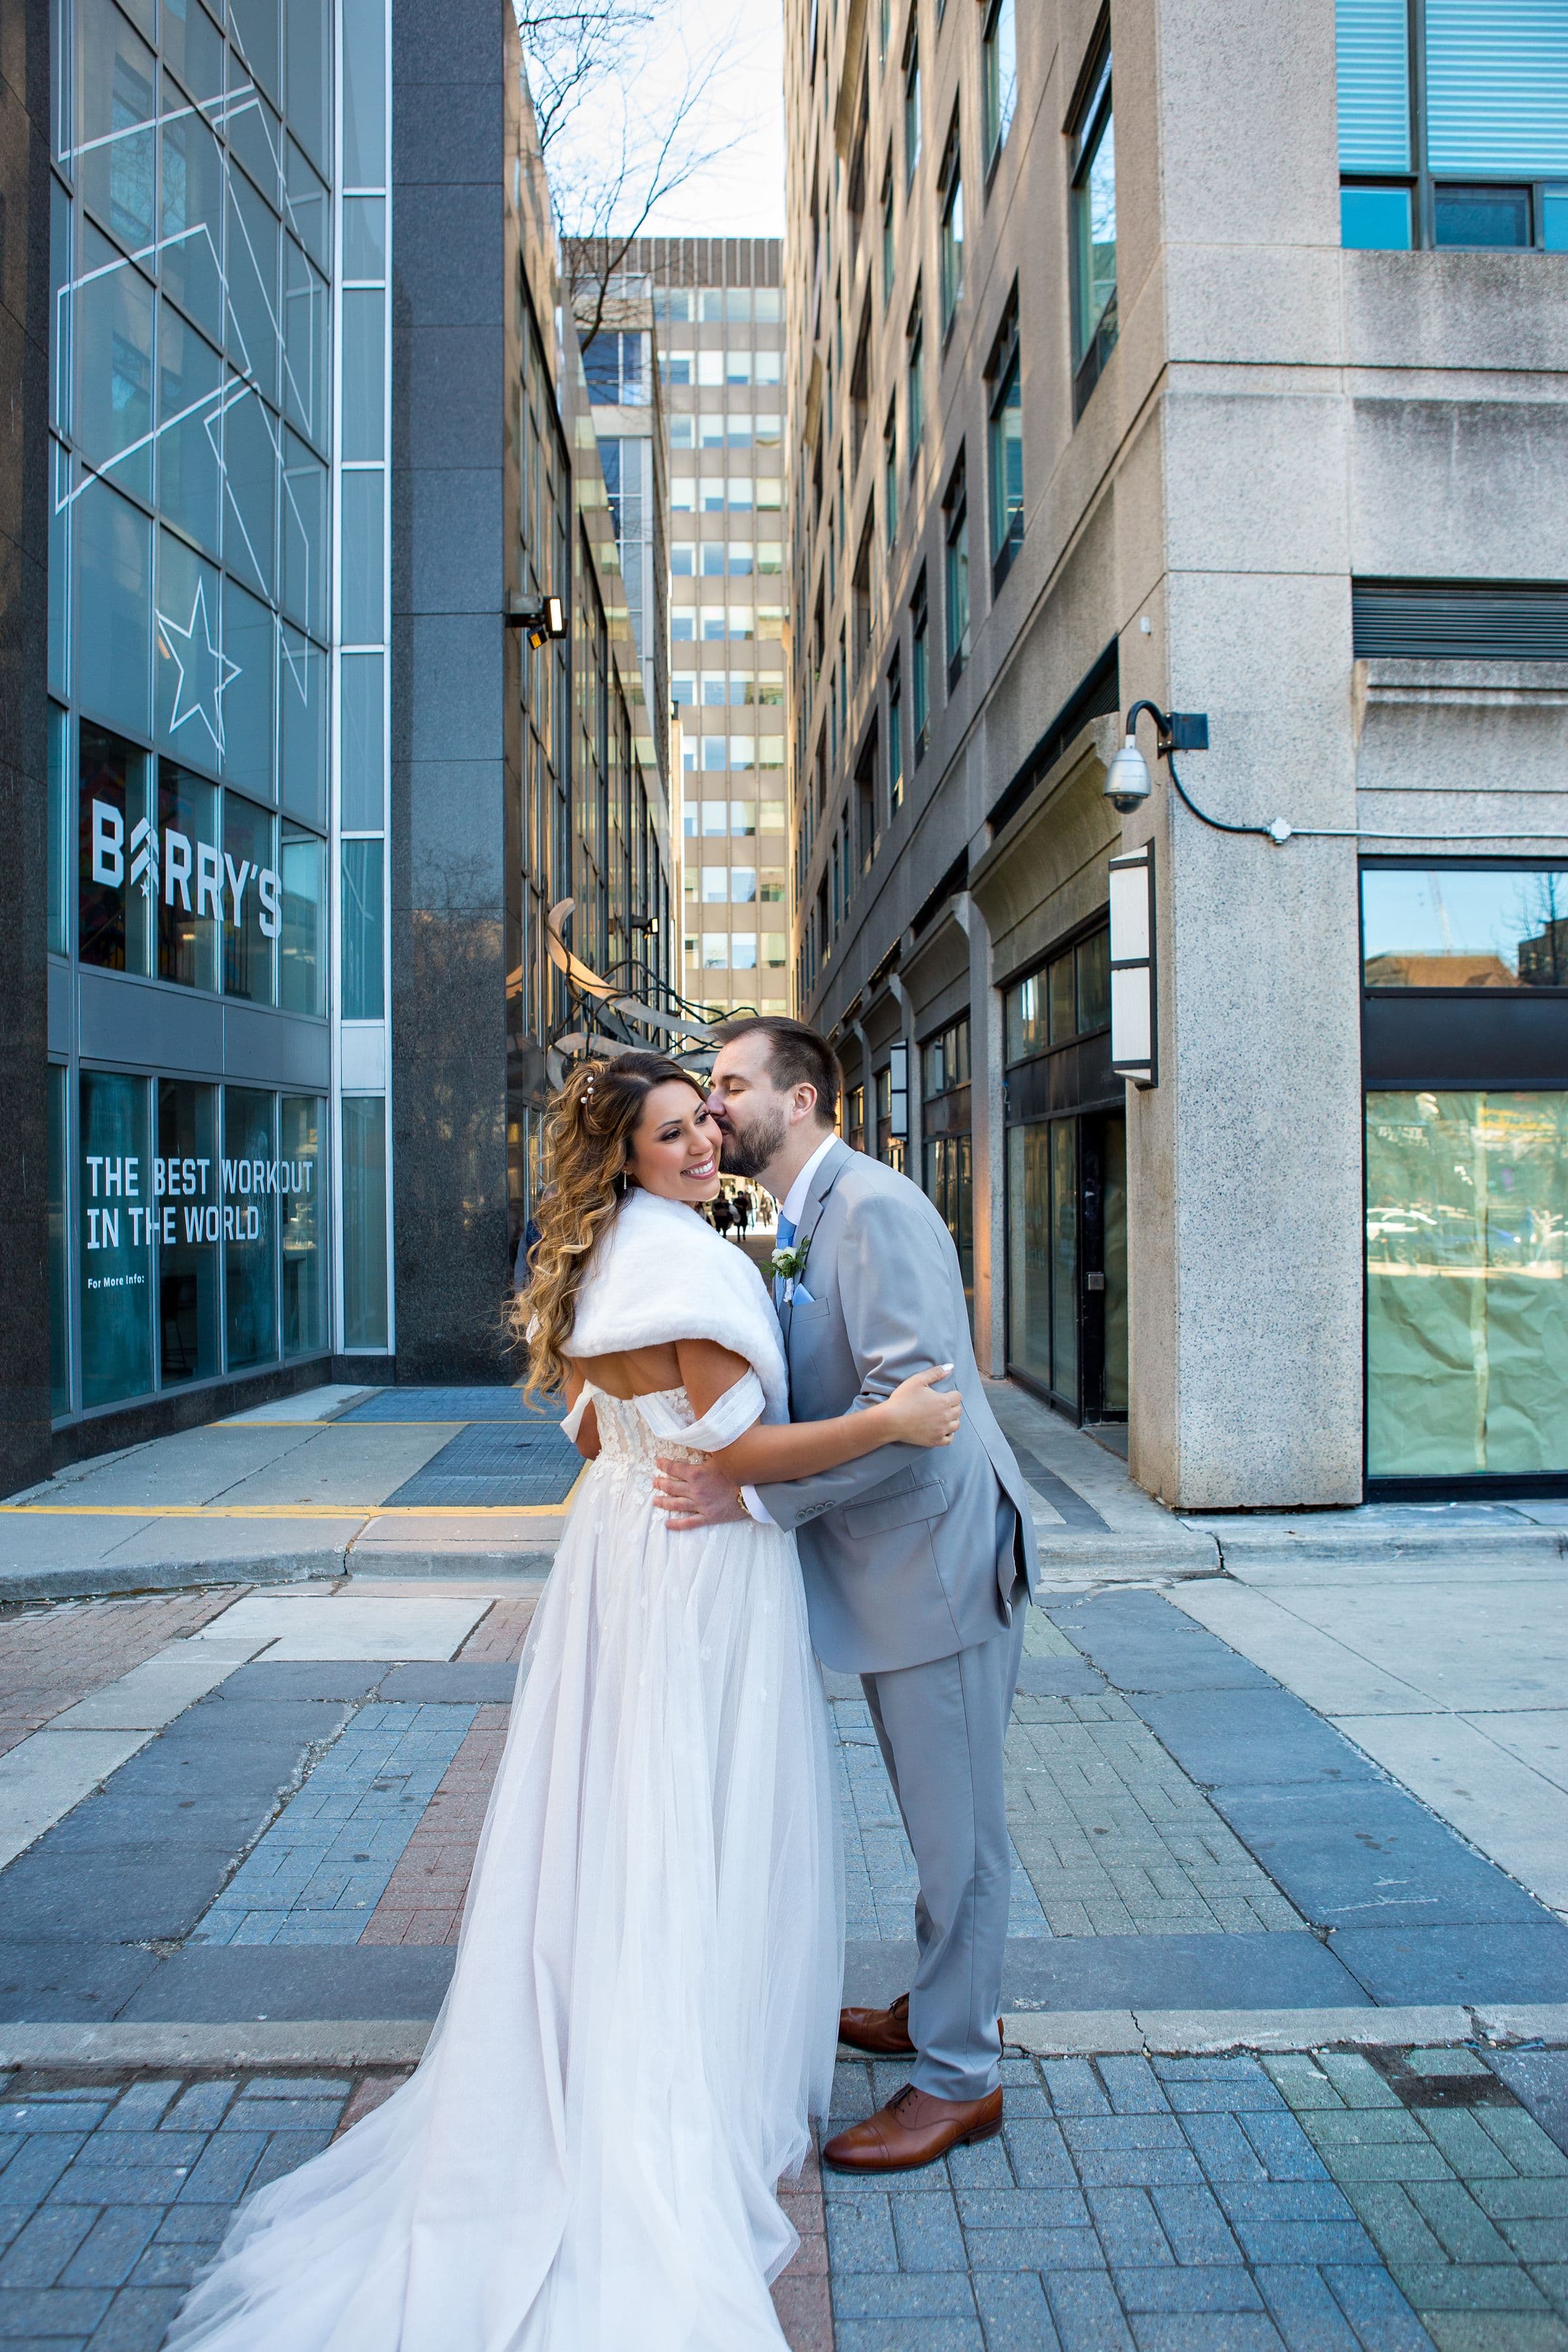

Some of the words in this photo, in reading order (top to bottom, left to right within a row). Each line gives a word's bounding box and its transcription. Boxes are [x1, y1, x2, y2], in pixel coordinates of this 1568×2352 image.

[86, 1156, 139, 1197] THE
[154, 1157, 210, 1196] BEST
[221, 1158, 314, 1194] WORKOUT
[87, 1208, 120, 1249] IN
[128, 1206, 176, 1246] THE
[184, 1205, 259, 1243] WORLD
[88, 1278, 101, 1289] For
[103, 1277, 124, 1288] More
[125, 1273, 145, 1285] Info:
